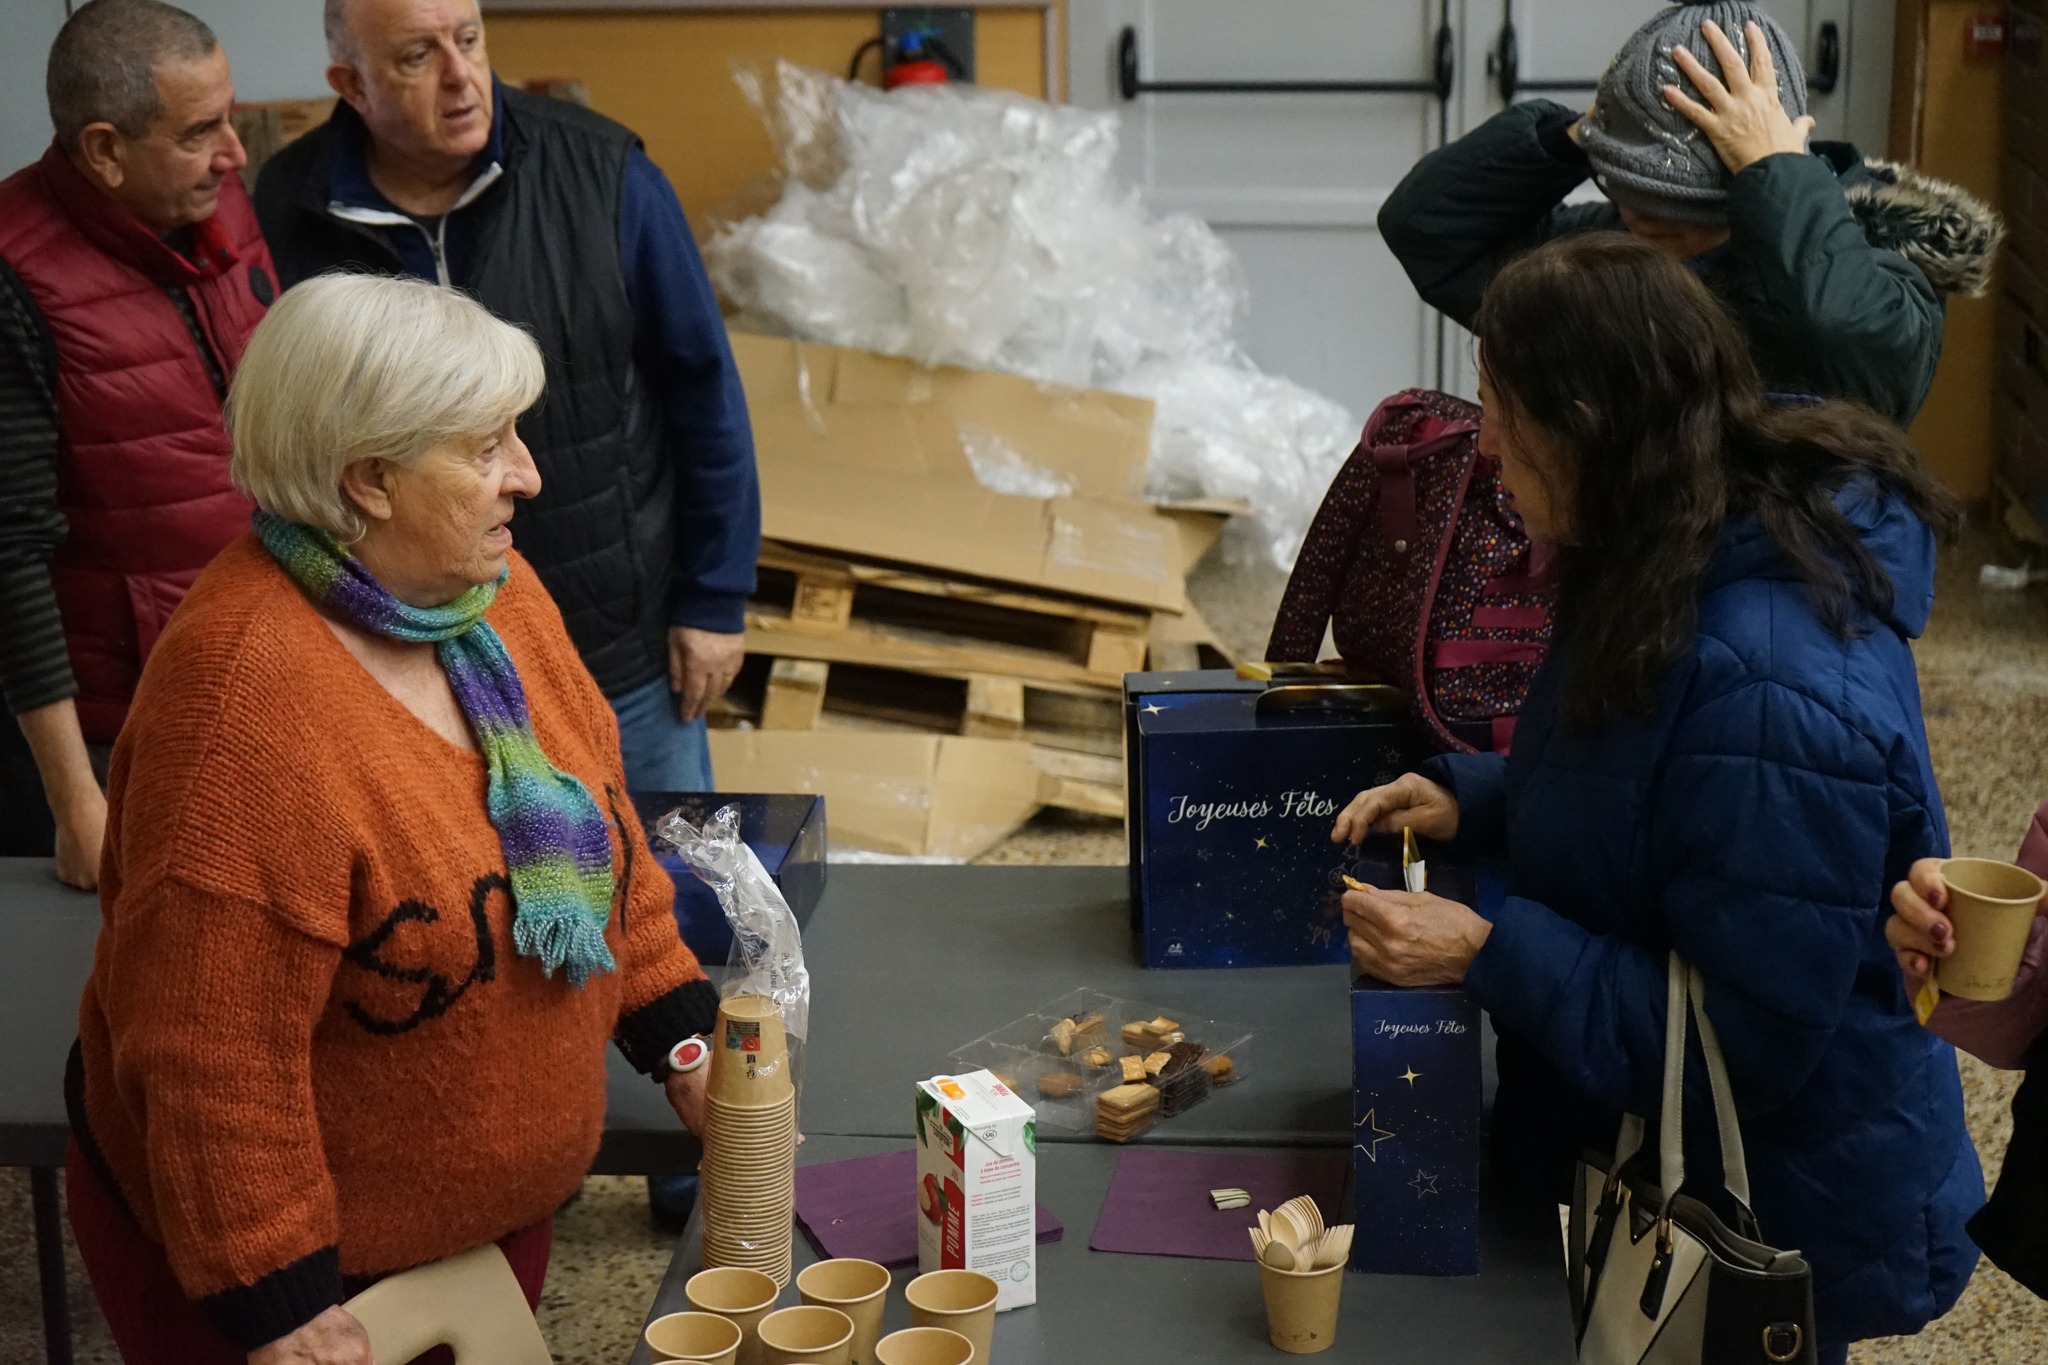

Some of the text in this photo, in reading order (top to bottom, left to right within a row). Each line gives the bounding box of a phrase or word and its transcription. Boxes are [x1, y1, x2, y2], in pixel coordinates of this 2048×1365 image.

[1168, 791, 1338, 831] Joyeuses Fêtes
[1374, 1019, 1467, 1039] Joyeuses Fêtes
[946, 1202, 960, 1259] POMME
